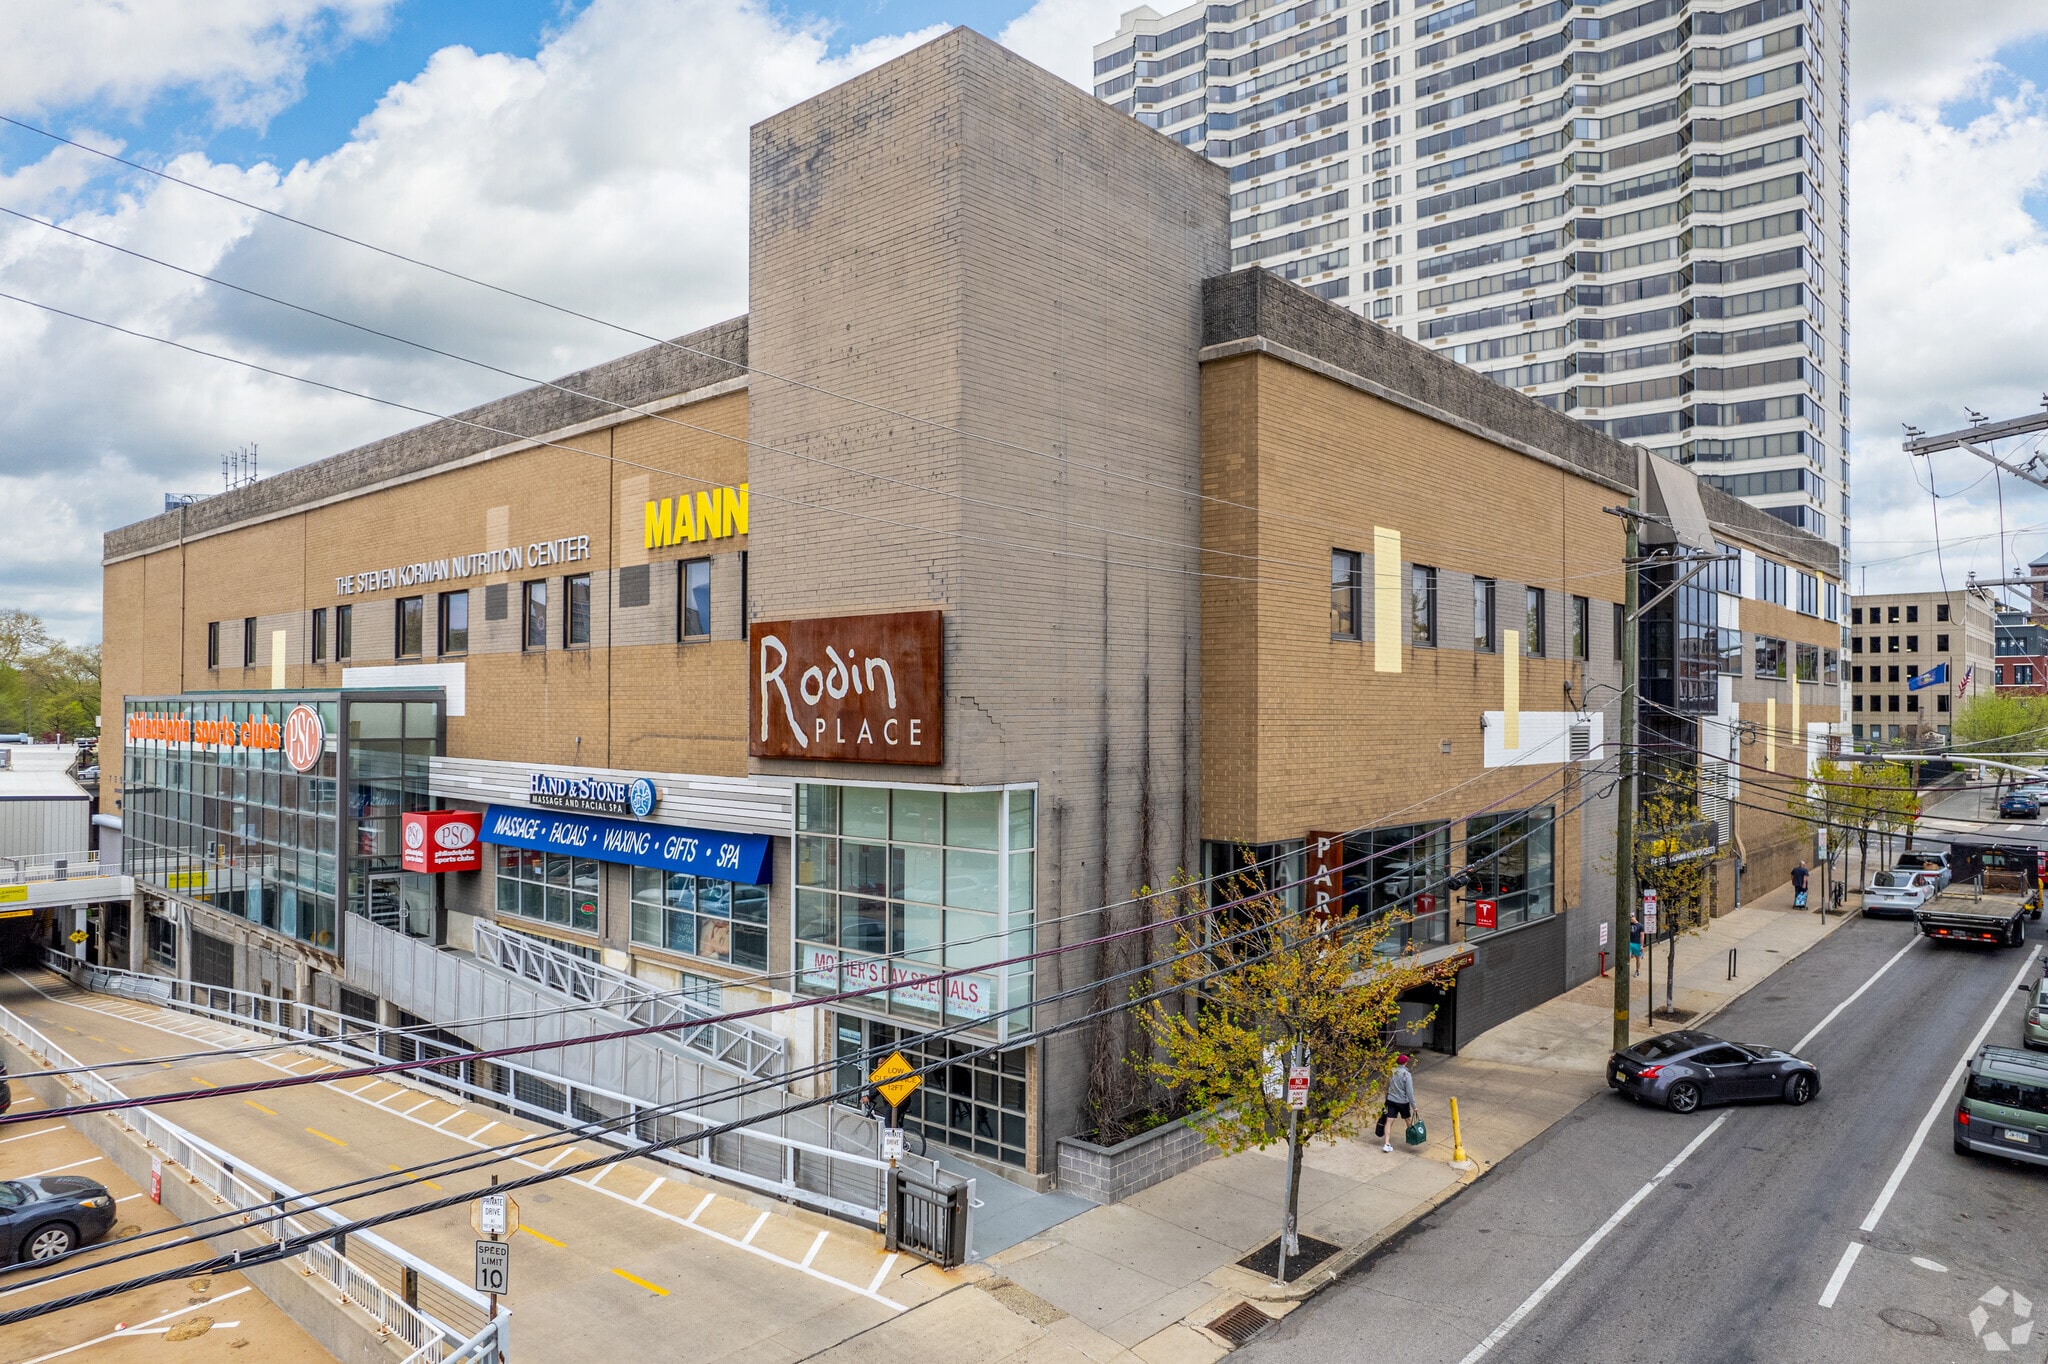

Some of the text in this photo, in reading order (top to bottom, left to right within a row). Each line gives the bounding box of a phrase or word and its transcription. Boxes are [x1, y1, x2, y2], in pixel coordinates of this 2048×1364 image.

[645, 483, 748, 549] MANN
[335, 535, 591, 596] THE STEVEN KORMAN NUTRITION CENTER
[761, 635, 896, 748] Rodin
[128, 711, 281, 750] philadelphia sports clubs
[288, 711, 316, 765] PSC
[815, 718, 921, 746] PLACE
[530, 774, 626, 803] HAND & STONE
[532, 795, 623, 814] MASSAGE AND FACIAL SPA
[441, 825, 469, 846] PSC
[493, 815, 740, 870] MASSAGE FACIALS WAXING GIFTS SPA
[887, 1067, 905, 1075] LOW
[482, 1197, 503, 1207] PRIVATE
[485, 1207, 501, 1216] DRIVE
[478, 1245, 507, 1256] SPEED
[481, 1257, 503, 1267] LIMIT
[481, 1267, 503, 1289] 10
